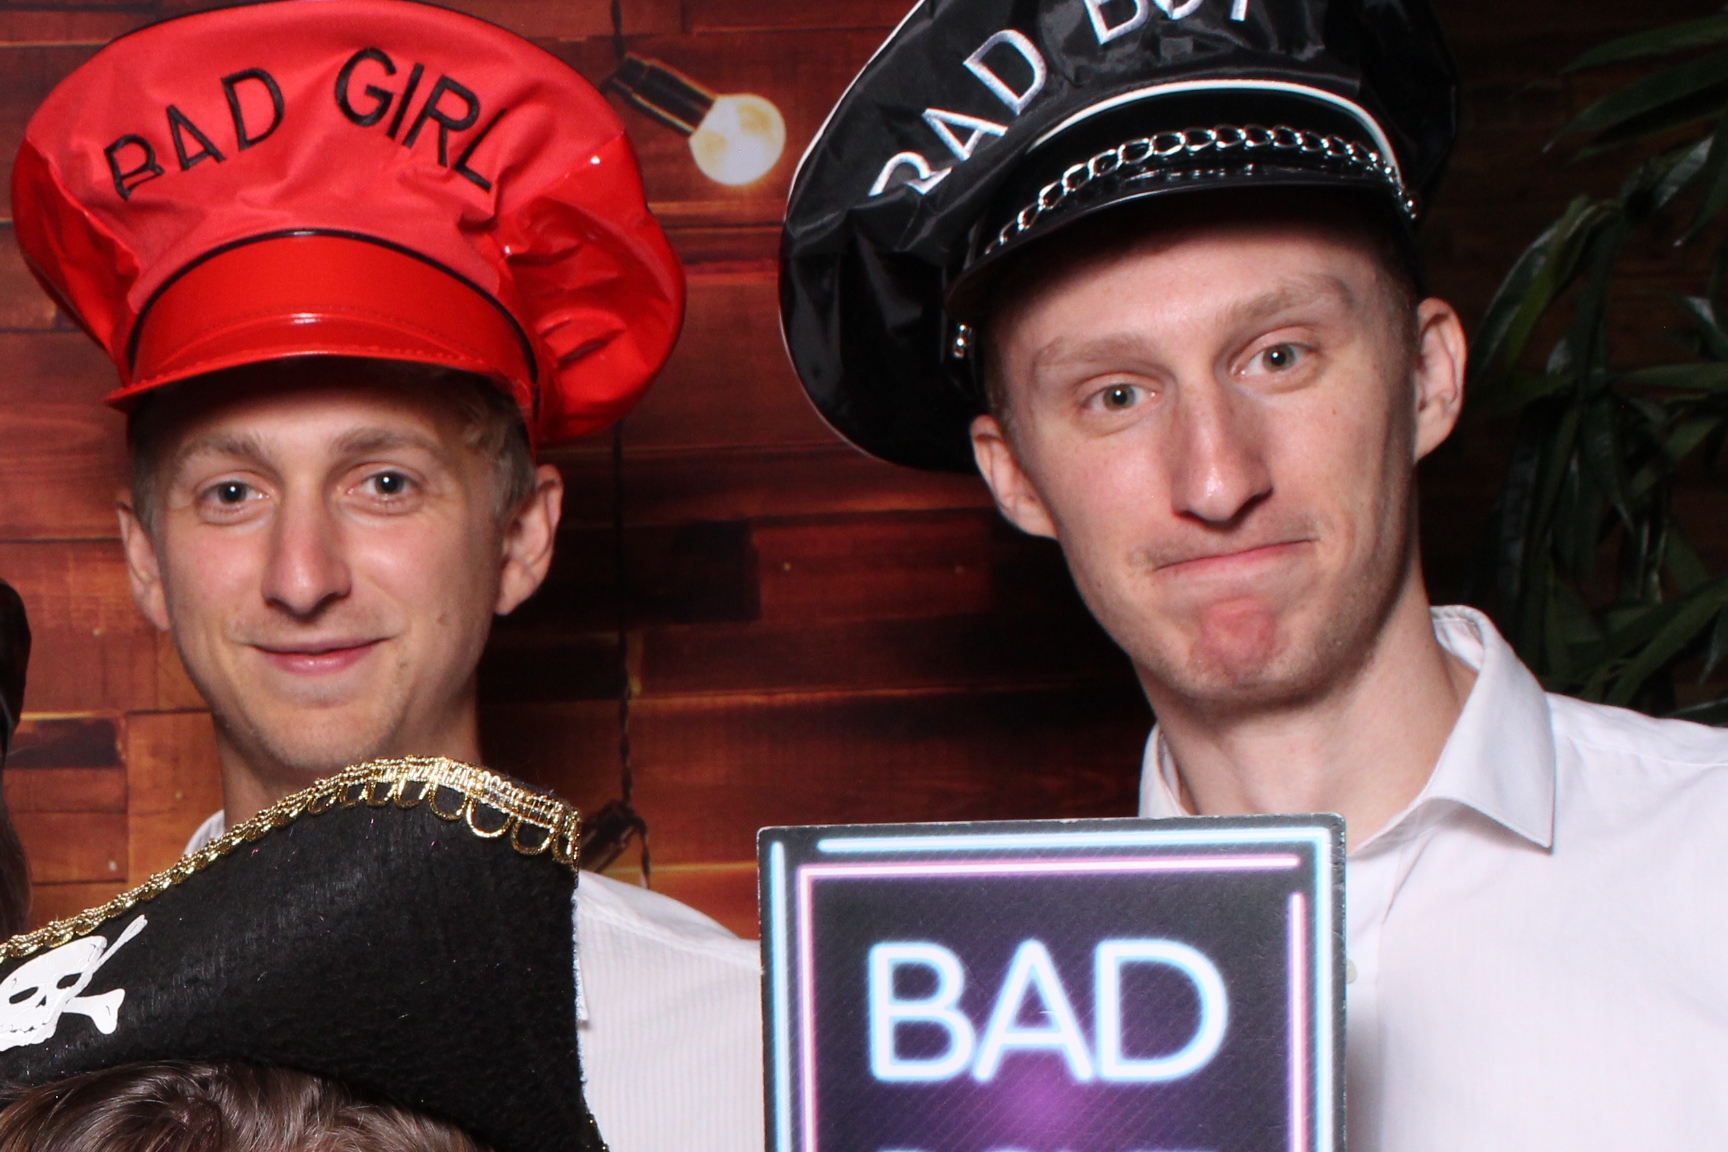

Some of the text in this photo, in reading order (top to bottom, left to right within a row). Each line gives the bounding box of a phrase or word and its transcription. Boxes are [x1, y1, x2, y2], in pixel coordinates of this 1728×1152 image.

[103, 46, 510, 201] BAD GIRL
[867, 937, 1229, 1084] BAD
